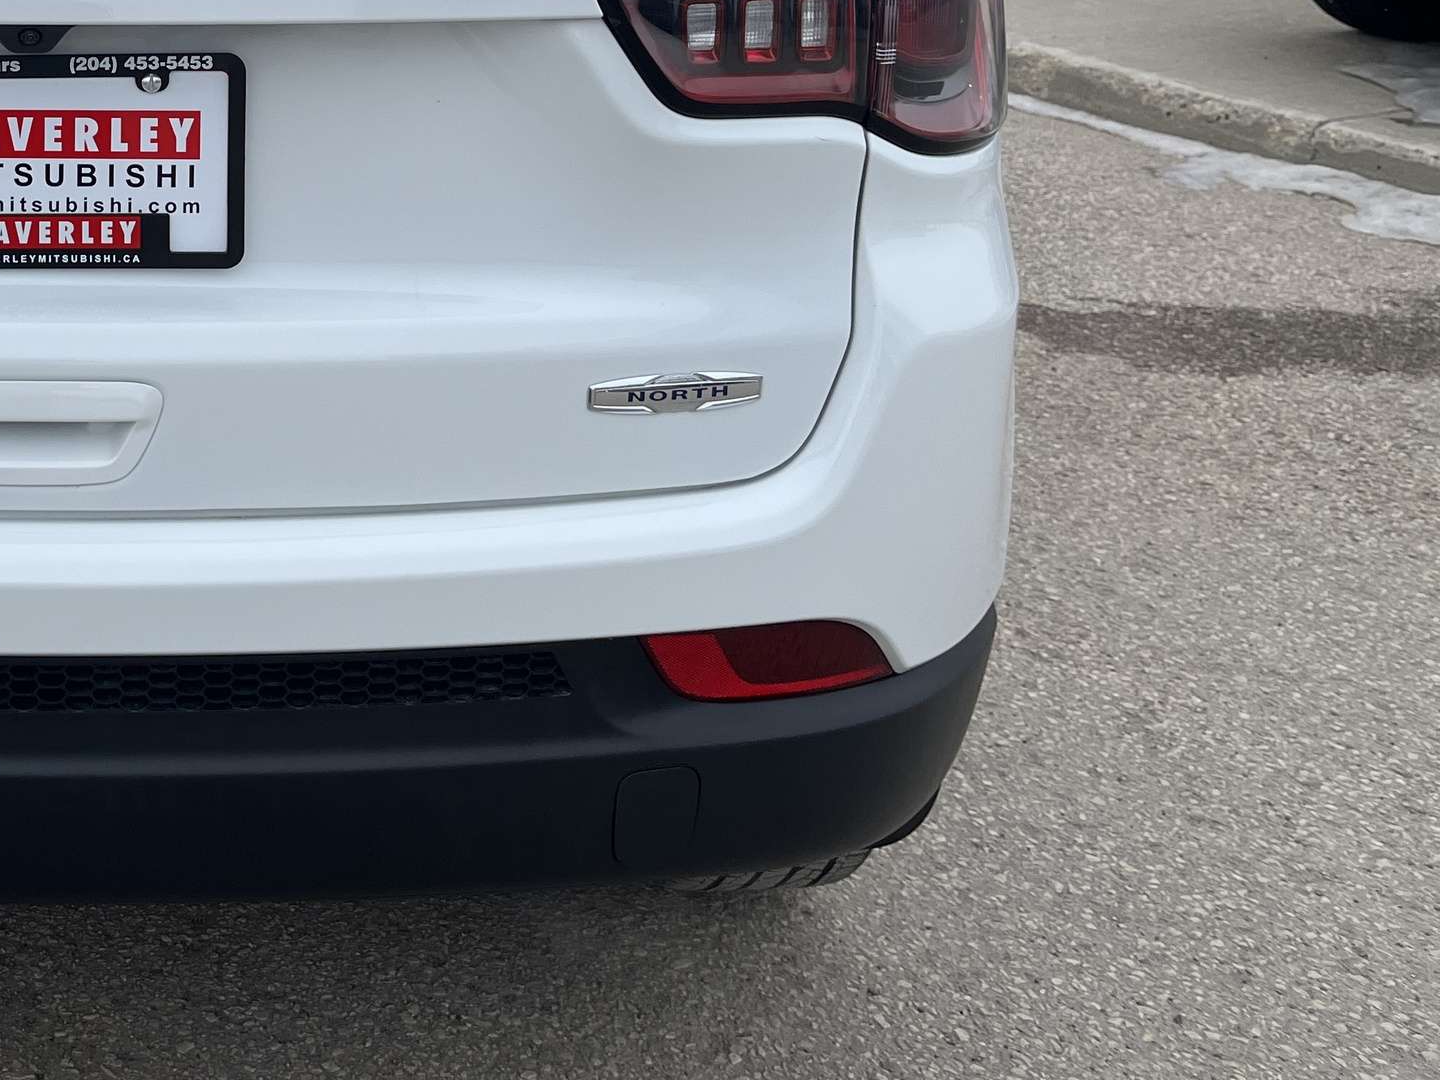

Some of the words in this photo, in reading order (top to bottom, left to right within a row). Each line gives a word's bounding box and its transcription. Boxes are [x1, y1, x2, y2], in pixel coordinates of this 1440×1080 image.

[69, 56, 117, 74] (204)
[124, 56, 213, 70] 453-5453
[628, 385, 728, 402] NORTH
